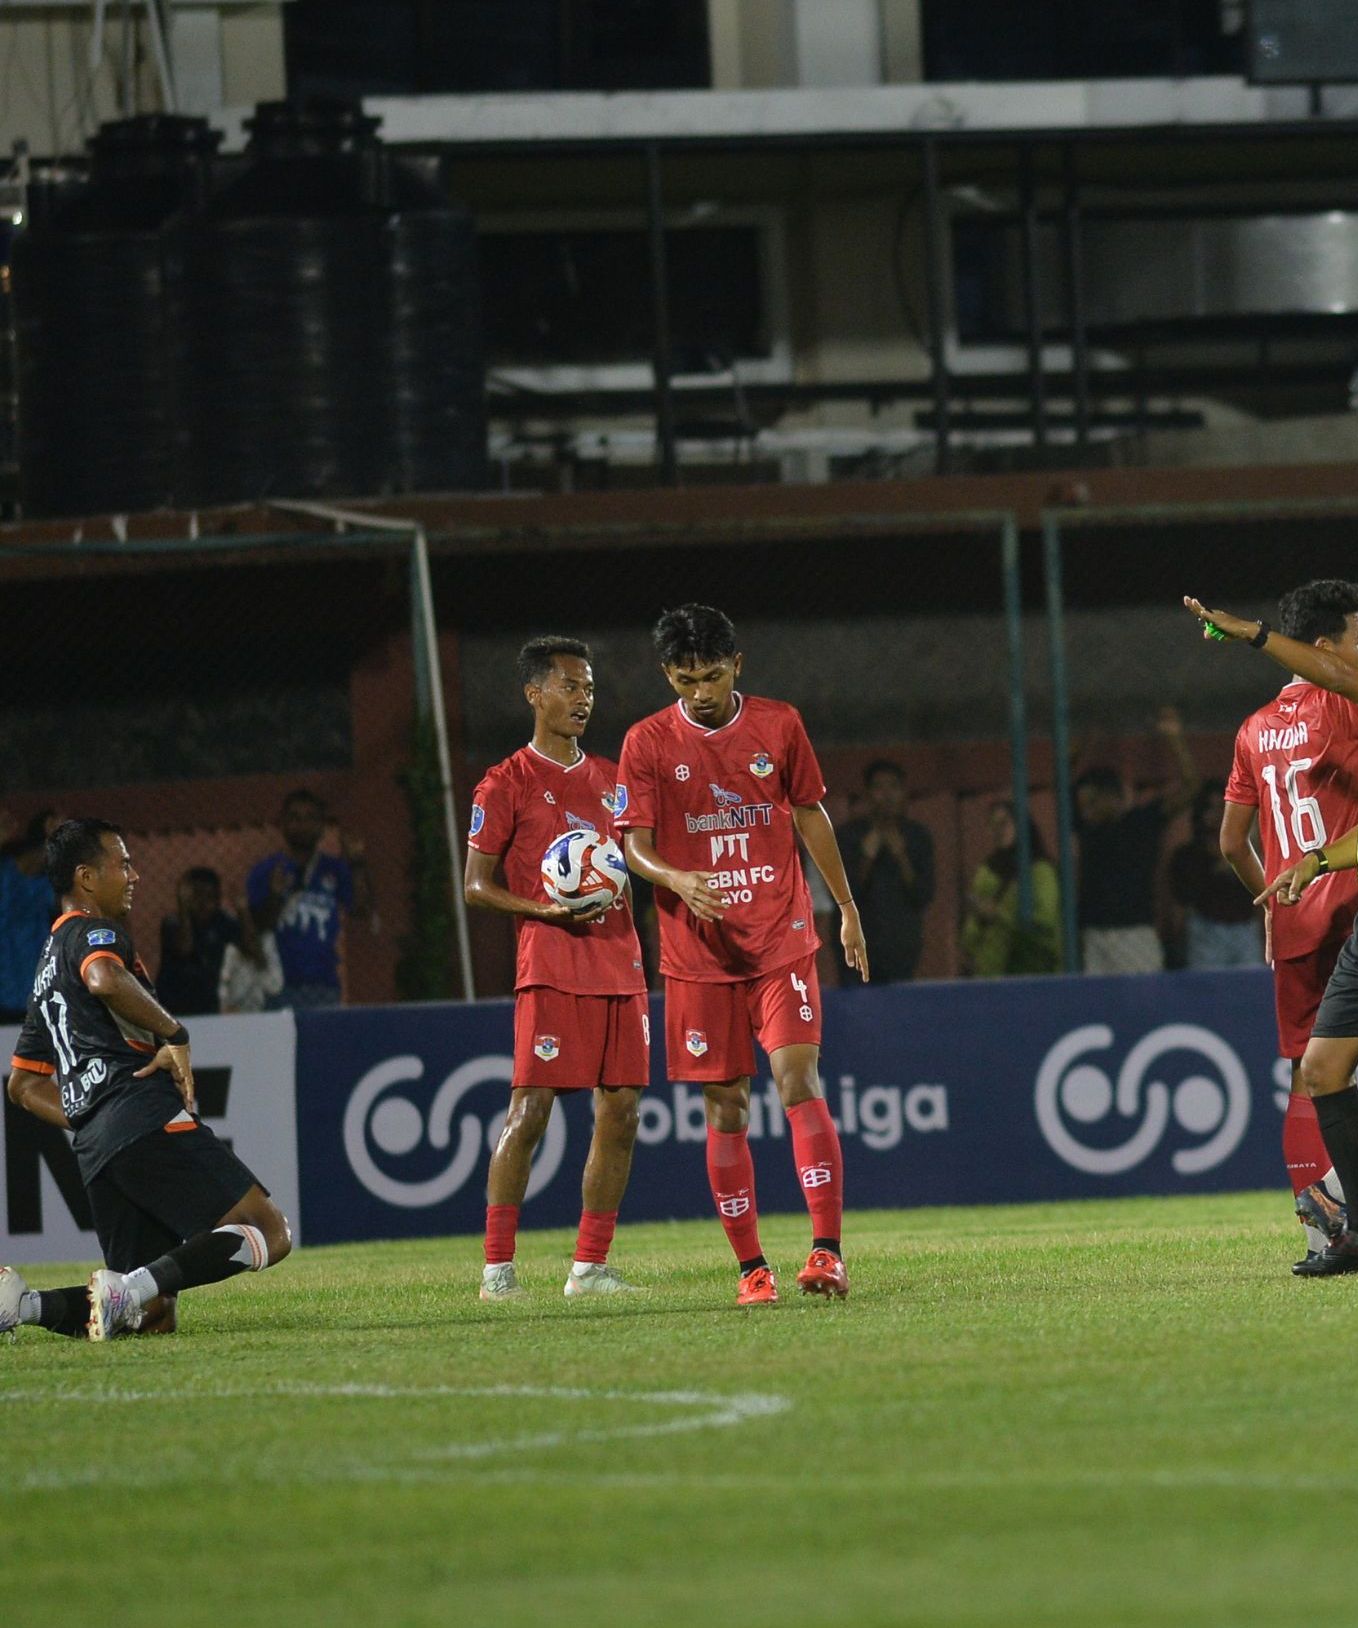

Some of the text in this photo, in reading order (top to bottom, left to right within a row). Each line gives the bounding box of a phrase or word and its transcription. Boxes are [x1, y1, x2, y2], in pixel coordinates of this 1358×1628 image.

[684, 803, 773, 833] bankNTT
[1261, 757, 1327, 859] 16
[710, 833, 750, 866] NTT
[750, 865, 775, 884] FC
[790, 972, 808, 1003] 4
